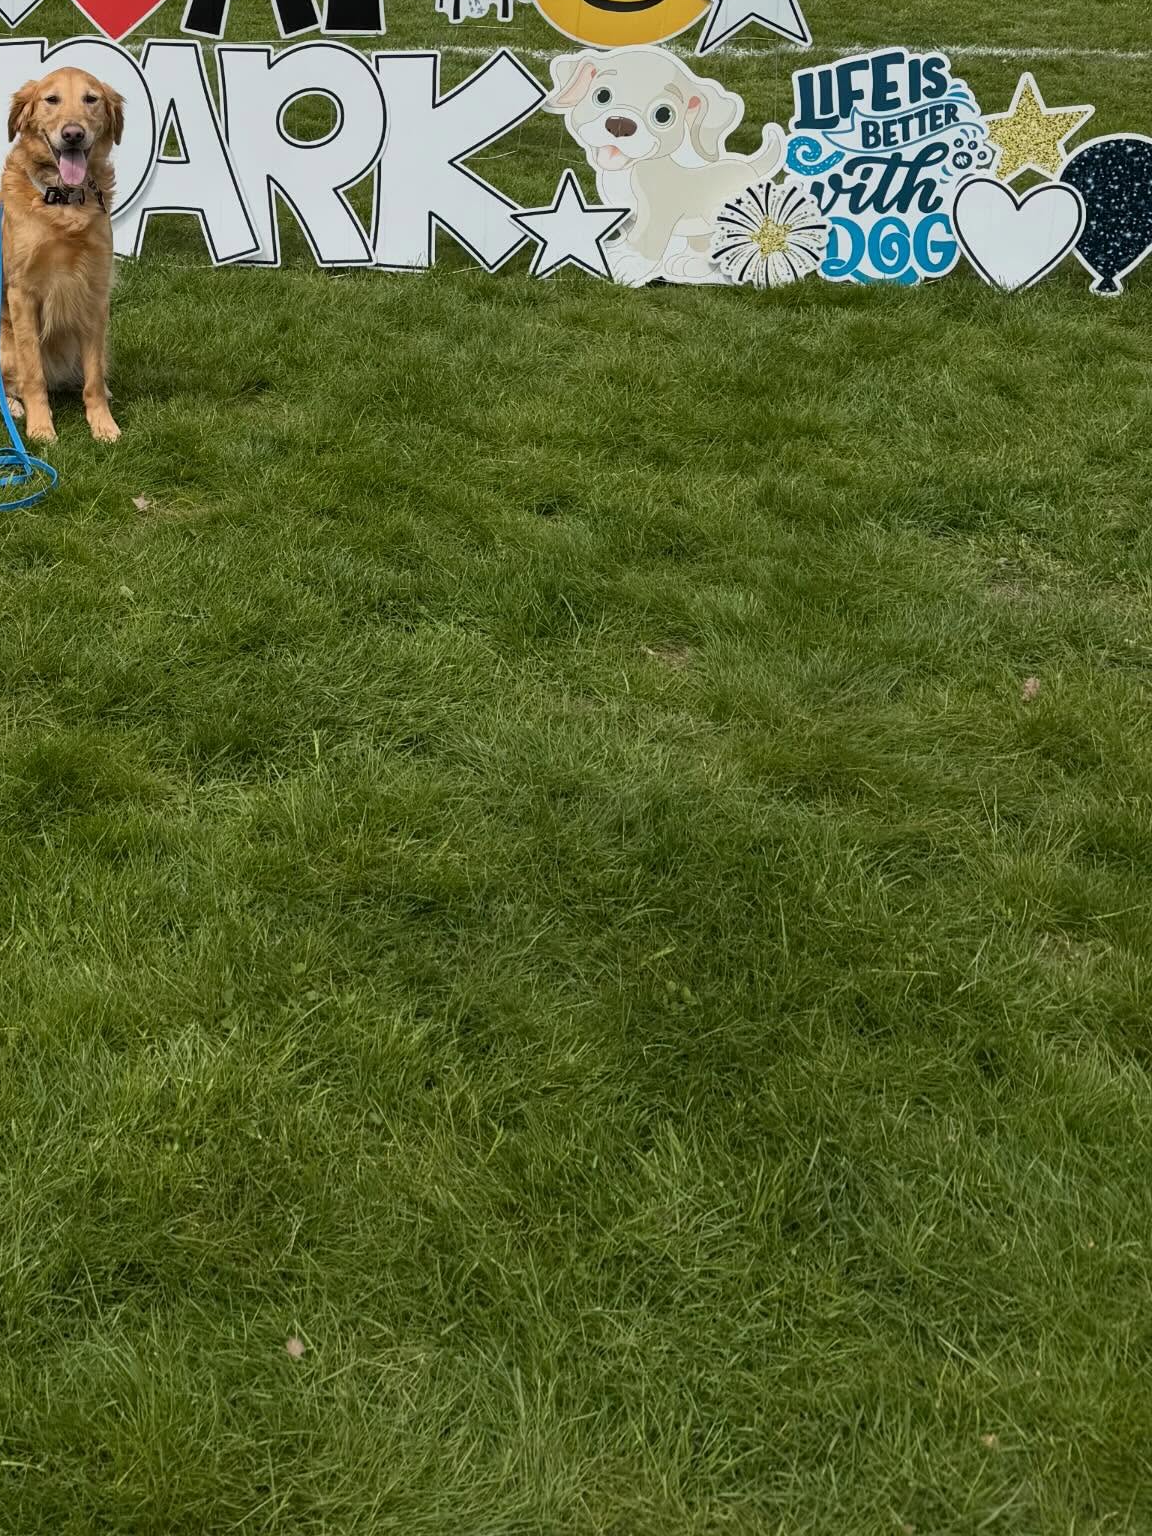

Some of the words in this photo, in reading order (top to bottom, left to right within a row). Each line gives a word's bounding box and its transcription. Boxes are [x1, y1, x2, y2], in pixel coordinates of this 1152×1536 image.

[794, 52, 905, 130] LIFE
[908, 57, 948, 104] IS
[861, 103, 960, 149] BETTER
[821, 213, 958, 279] DOG
